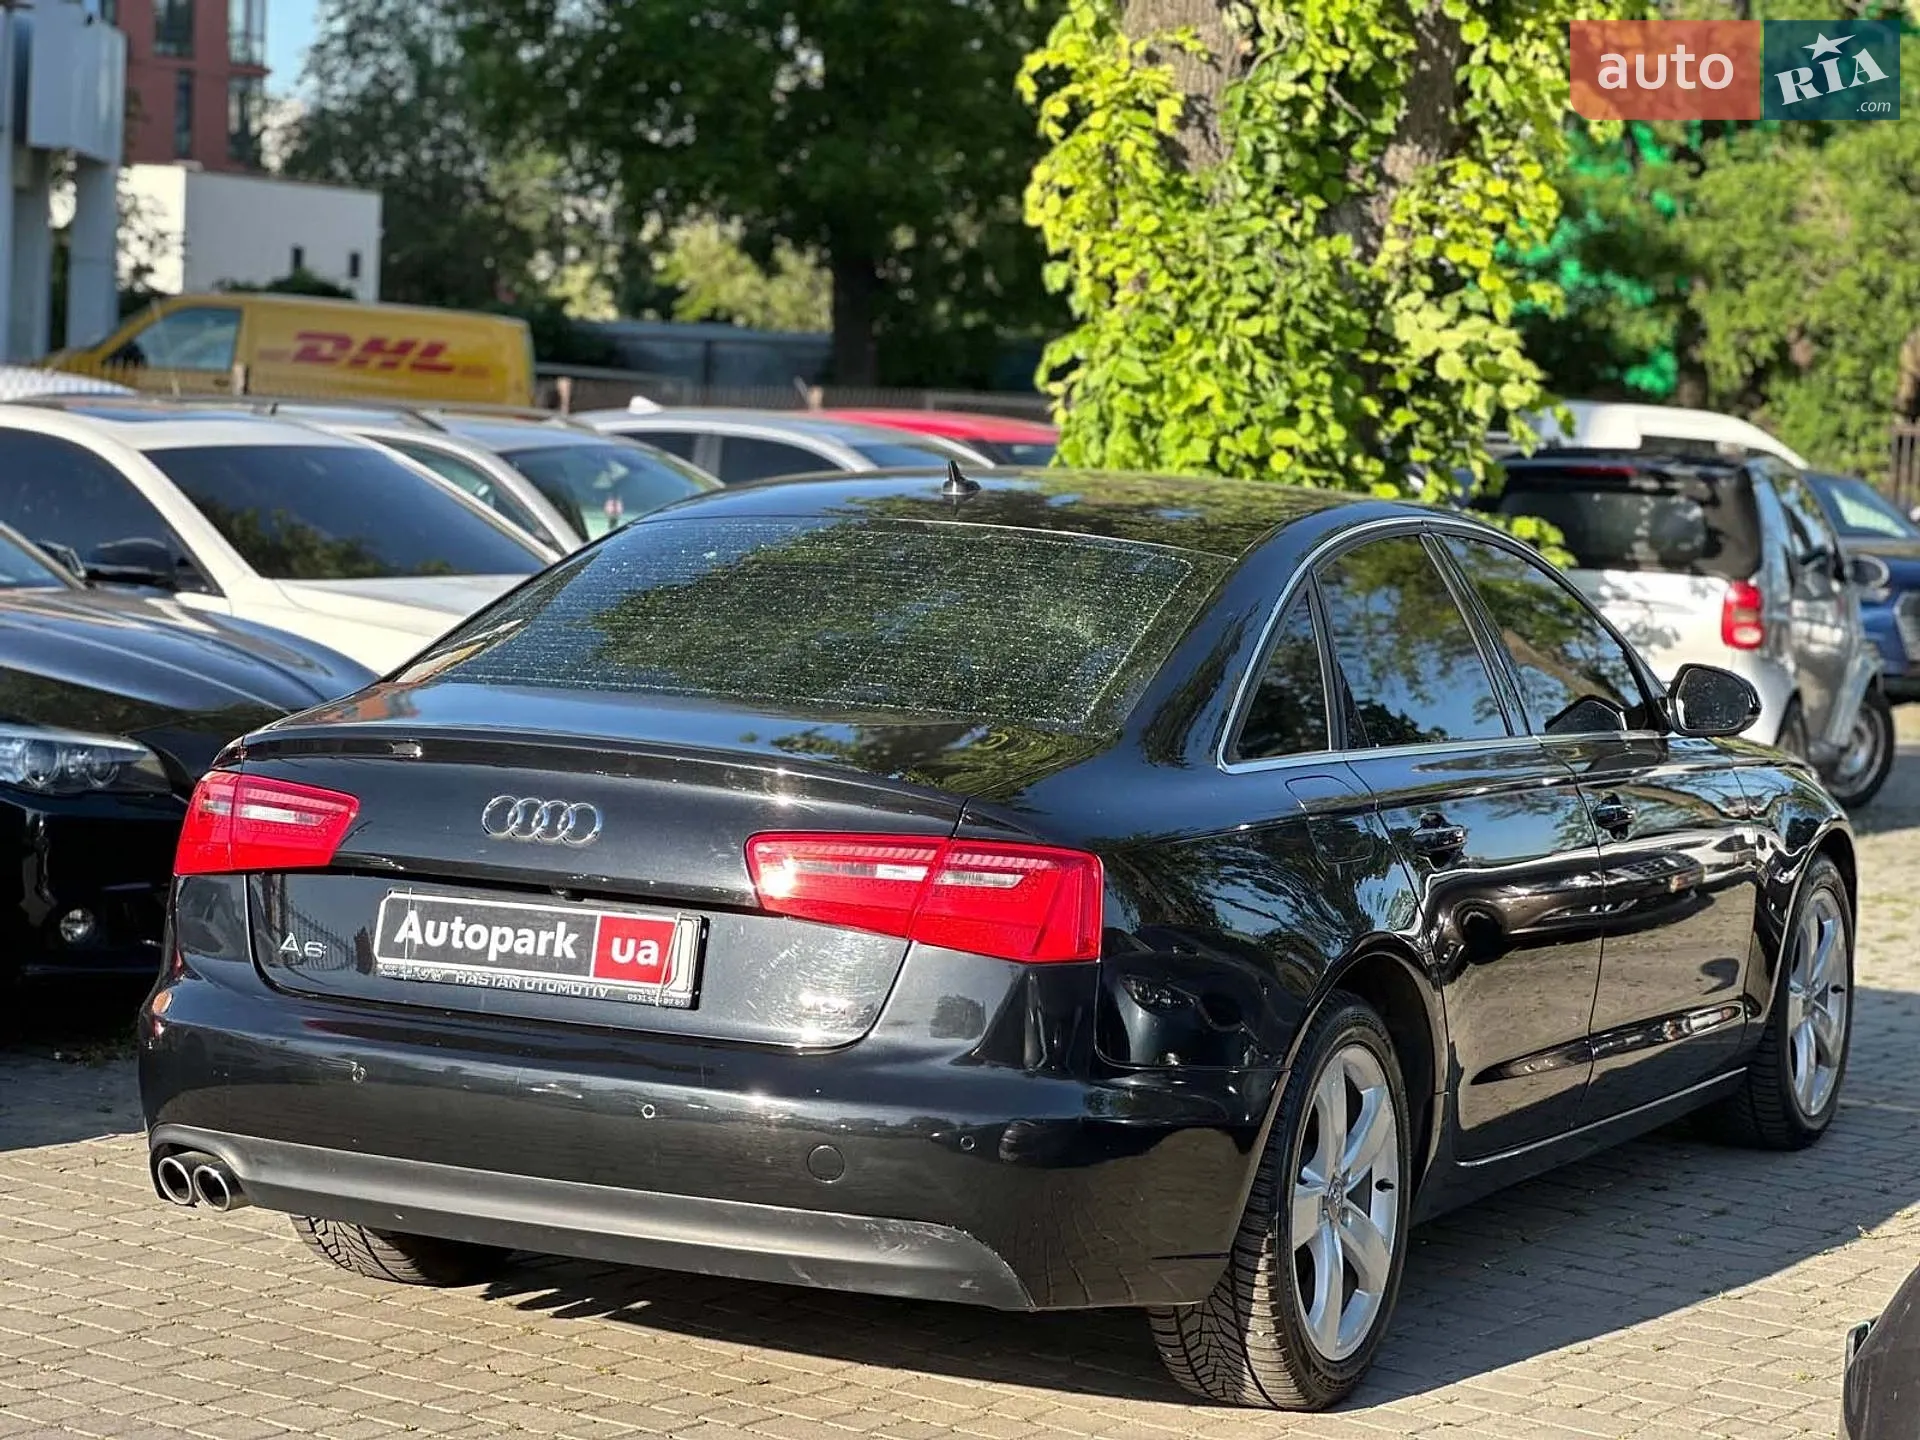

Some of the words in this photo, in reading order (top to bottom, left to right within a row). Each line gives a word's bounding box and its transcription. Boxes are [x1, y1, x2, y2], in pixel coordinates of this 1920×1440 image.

[292, 331, 454, 374] DHL
[279, 931, 326, 958] A6
[394, 910, 577, 961] Autopark
[610, 936, 660, 966] ua
